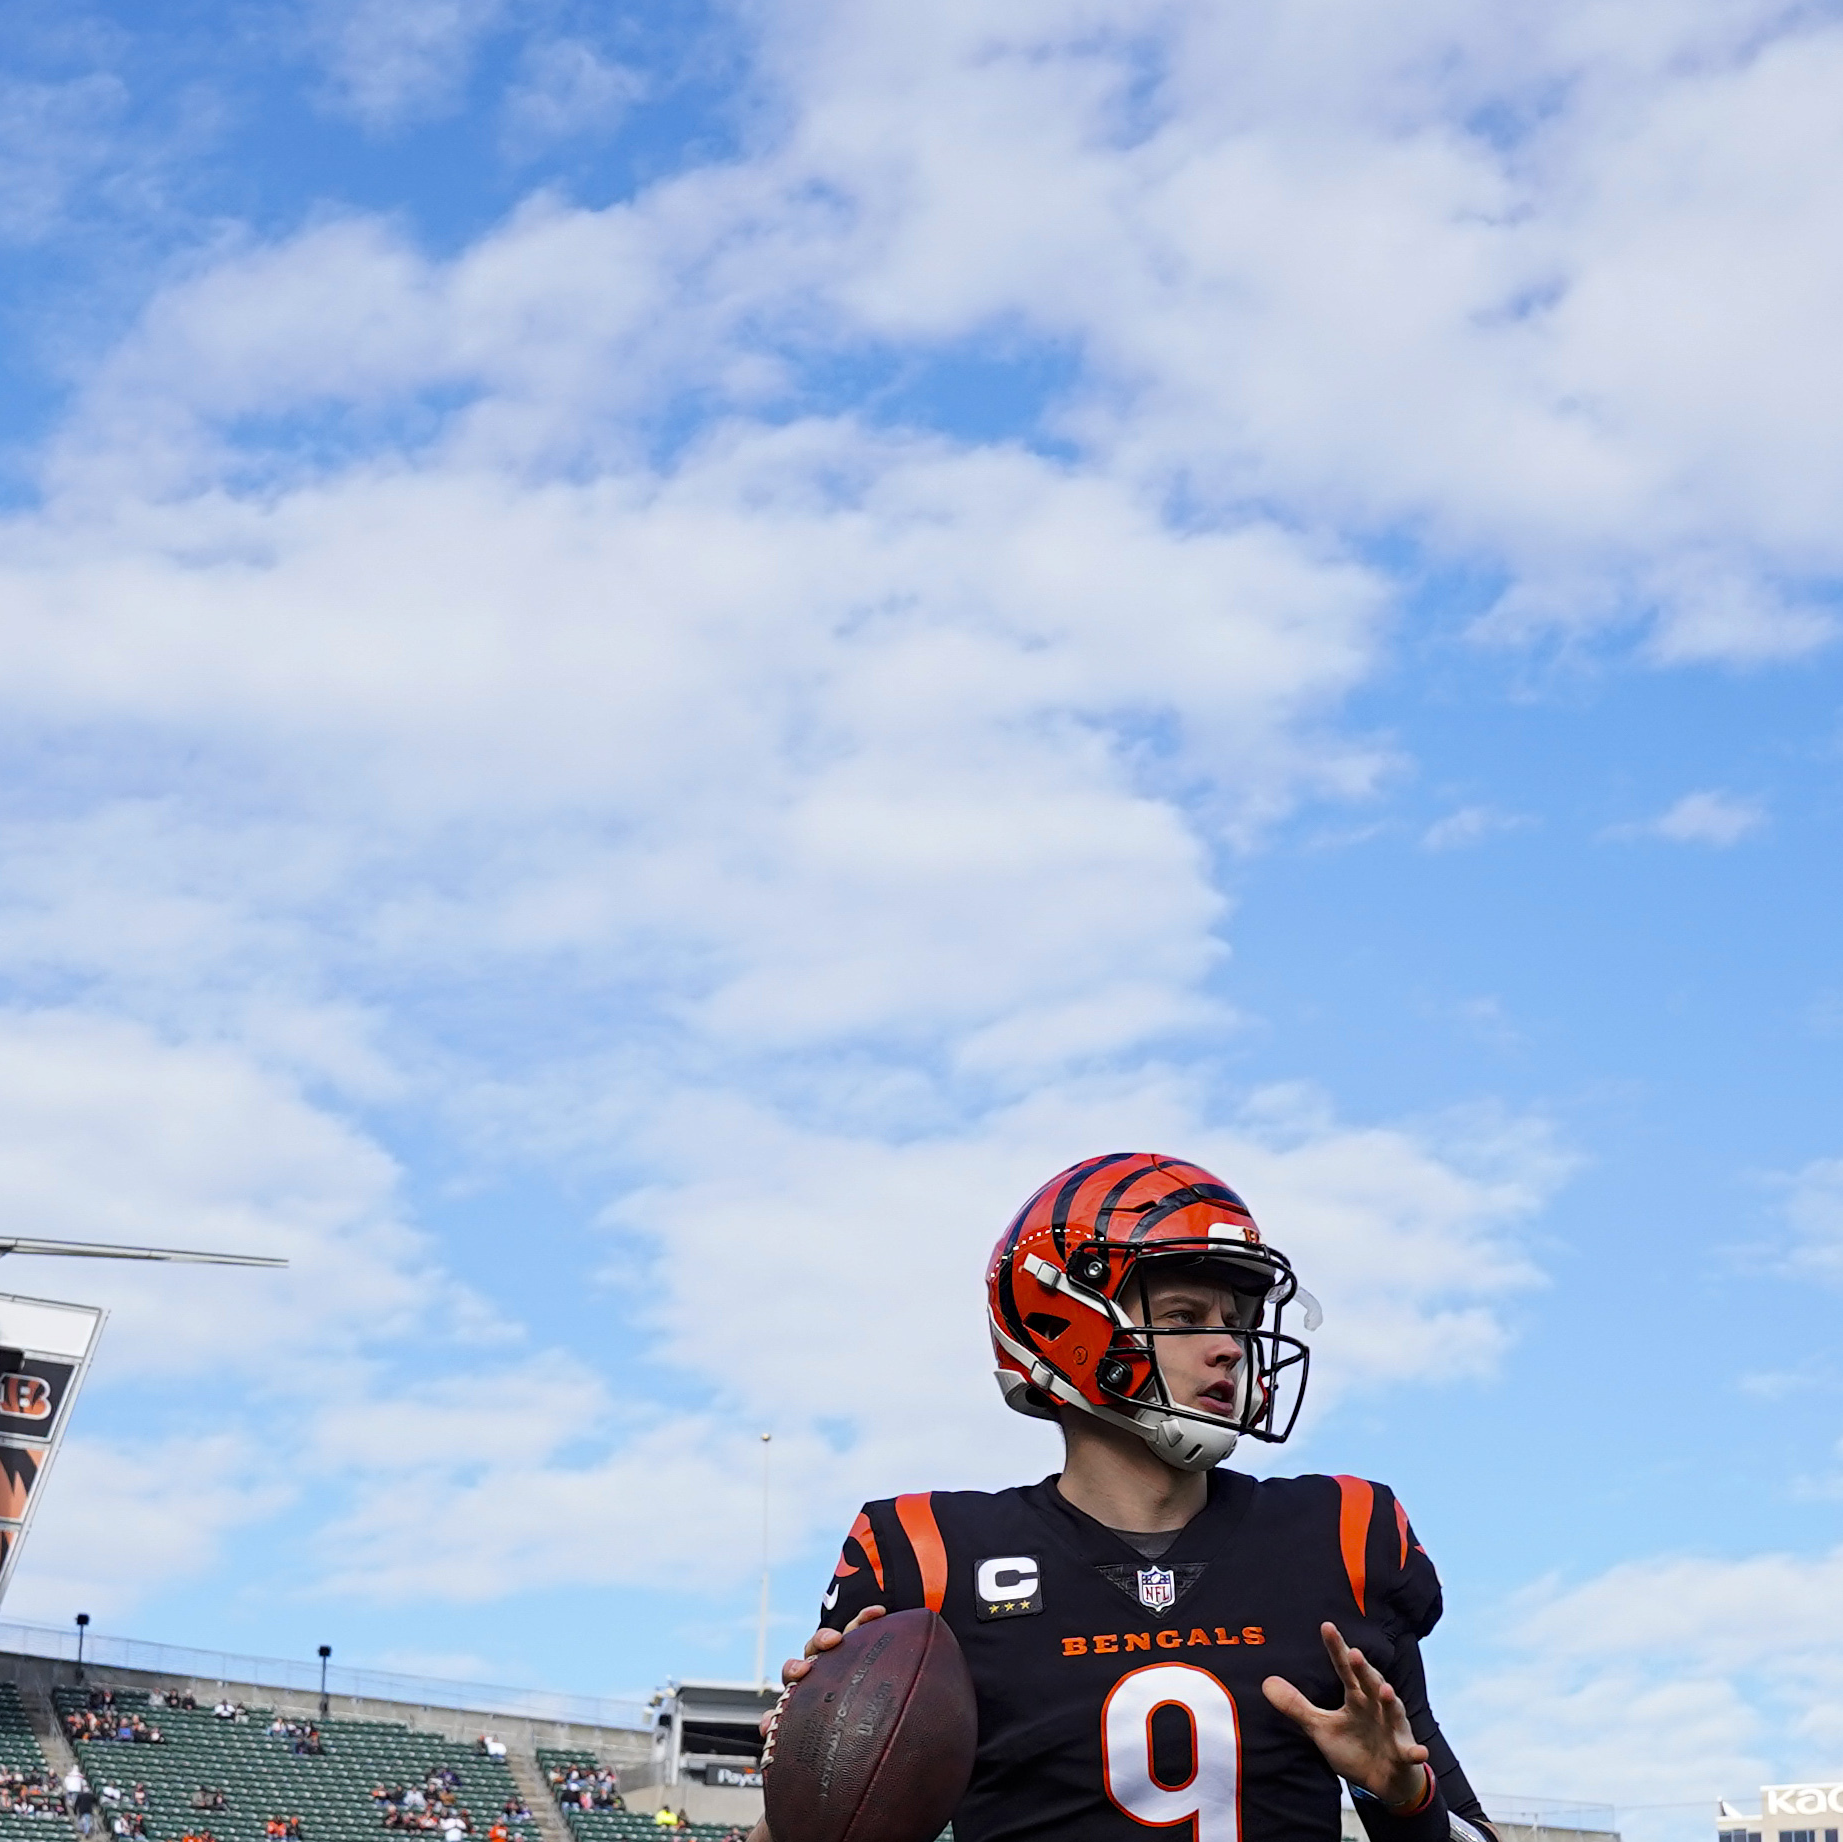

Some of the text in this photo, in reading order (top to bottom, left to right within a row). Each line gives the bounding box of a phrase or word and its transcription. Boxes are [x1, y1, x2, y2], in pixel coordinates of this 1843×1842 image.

[977, 1556, 1038, 1601] C
[1145, 1585, 1169, 1602] NFL
[1061, 1626, 1266, 1656] BENGALS
